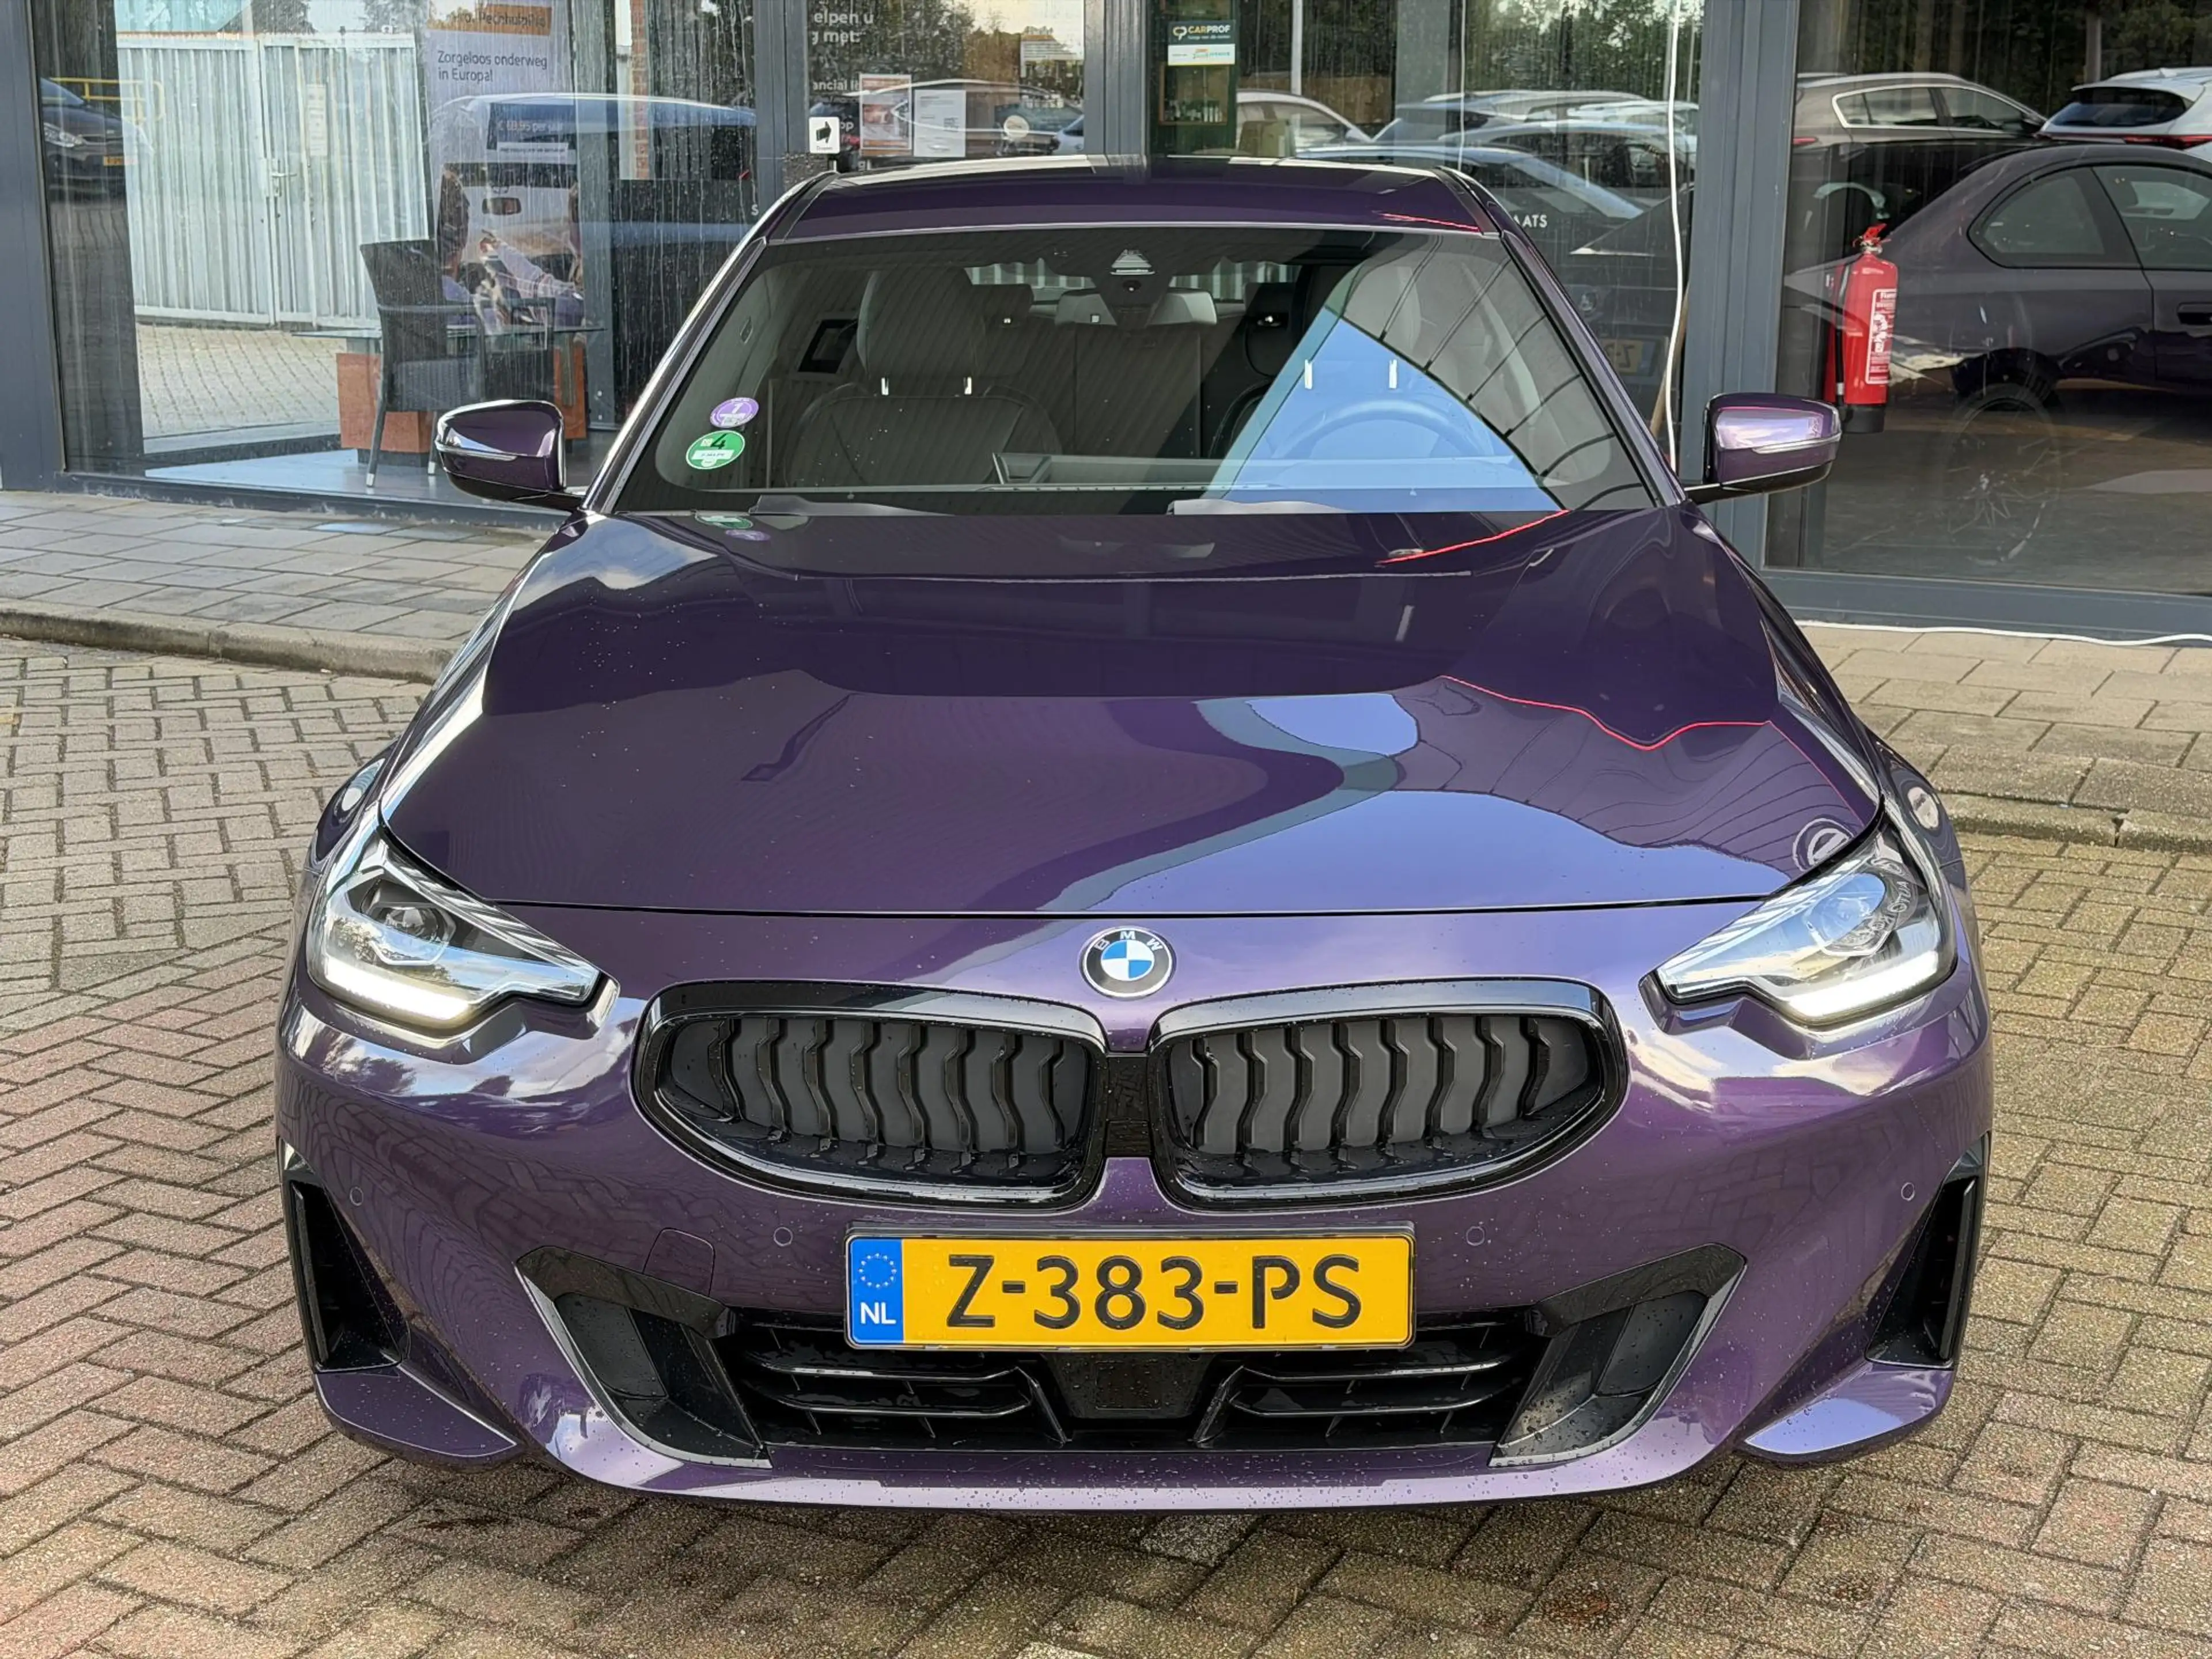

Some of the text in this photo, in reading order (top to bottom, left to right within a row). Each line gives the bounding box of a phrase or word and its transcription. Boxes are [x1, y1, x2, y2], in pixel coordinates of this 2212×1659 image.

[865, 14, 874, 24] u
[1188, 25, 1230, 33] CARPROF
[437, 51, 547, 70] Zorgeloos onderweg
[438, 67, 449, 80] in
[711, 433, 727, 449] 4
[1094, 930, 1164, 952] BMW
[946, 1255, 1362, 1330] Z-383-PS
[860, 1302, 897, 1324] NL
